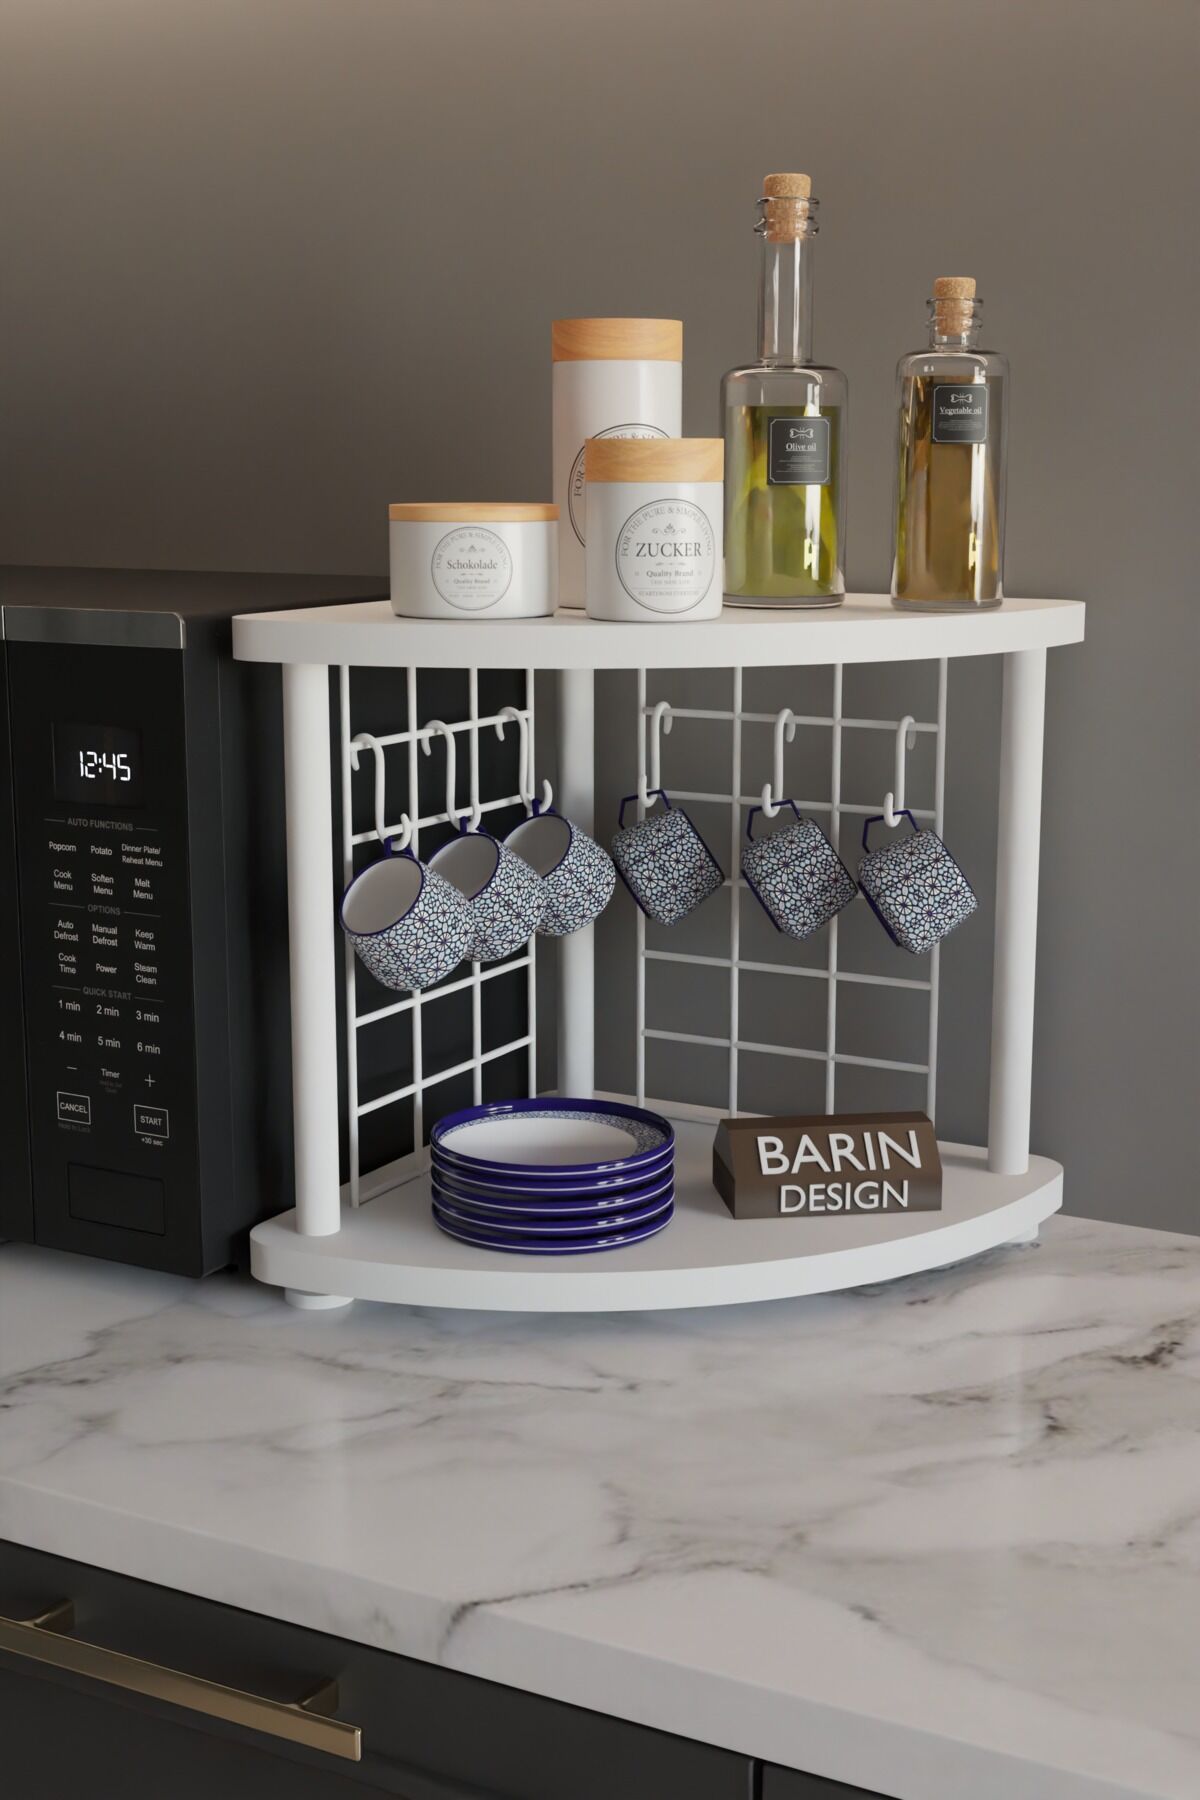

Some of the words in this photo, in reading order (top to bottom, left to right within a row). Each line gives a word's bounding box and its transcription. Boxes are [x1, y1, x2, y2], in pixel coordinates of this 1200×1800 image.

[940, 407, 972, 416] Vegetable
[973, 407, 982, 415] oil
[786, 442, 806, 452] Olive
[807, 442, 817, 452] oil
[621, 536, 632, 557] FOR
[627, 518, 643, 534] THE
[635, 542, 702, 558] ZUCKER
[446, 560, 498, 570] Schokolade
[646, 570, 672, 578] Quality
[674, 570, 694, 578] Brand
[80, 751, 130, 781] 12:45
[67, 818, 88, 827] AUTO
[90, 820, 134, 831] FUNCTIONS
[48, 841, 76, 852] Popcorn
[90, 846, 112, 856] Potato
[122, 844, 142, 853] Dinner
[122, 856, 144, 866] Reheat
[145, 858, 162, 867] Menu
[54, 868, 72, 879] Cook
[92, 873, 114, 884] Soften
[54, 881, 73, 891] Menu
[134, 878, 150, 888] Melt
[94, 886, 113, 896] Menu
[133, 890, 154, 900] Menu
[88, 904, 120, 916] OPTIONS
[58, 920, 74, 929] Auto
[92, 924, 118, 934] Manual
[54, 930, 78, 942] Defrost
[135, 929, 154, 940] Keep
[92, 936, 118, 946] Defrost
[134, 941, 156, 951] Warm
[58, 952, 76, 962] Cook
[59, 964, 76, 974] Time
[96, 963, 117, 974] Power
[134, 962, 158, 974] Steam
[136, 974, 156, 984] Clean
[82, 986, 106, 998] QUICK
[108, 990, 132, 1000] START
[58, 1000, 63, 1008] 1
[66, 1001, 80, 1012] min
[96, 1004, 102, 1014] 2
[104, 1006, 120, 1017] min
[136, 1010, 142, 1020] 3
[144, 1012, 160, 1022] min
[59, 1030, 64, 1040] 4
[66, 1032, 82, 1042] min
[98, 1036, 104, 1046] 5
[106, 1038, 120, 1048] min
[137, 1042, 142, 1052] 6
[145, 1044, 160, 1054] min
[100, 1068, 120, 1078] Timer
[60, 1102, 88, 1114] CANCEL
[140, 1116, 162, 1126] START
[757, 1130, 922, 1176] BARIN
[779, 1180, 909, 1213] DESIGN
